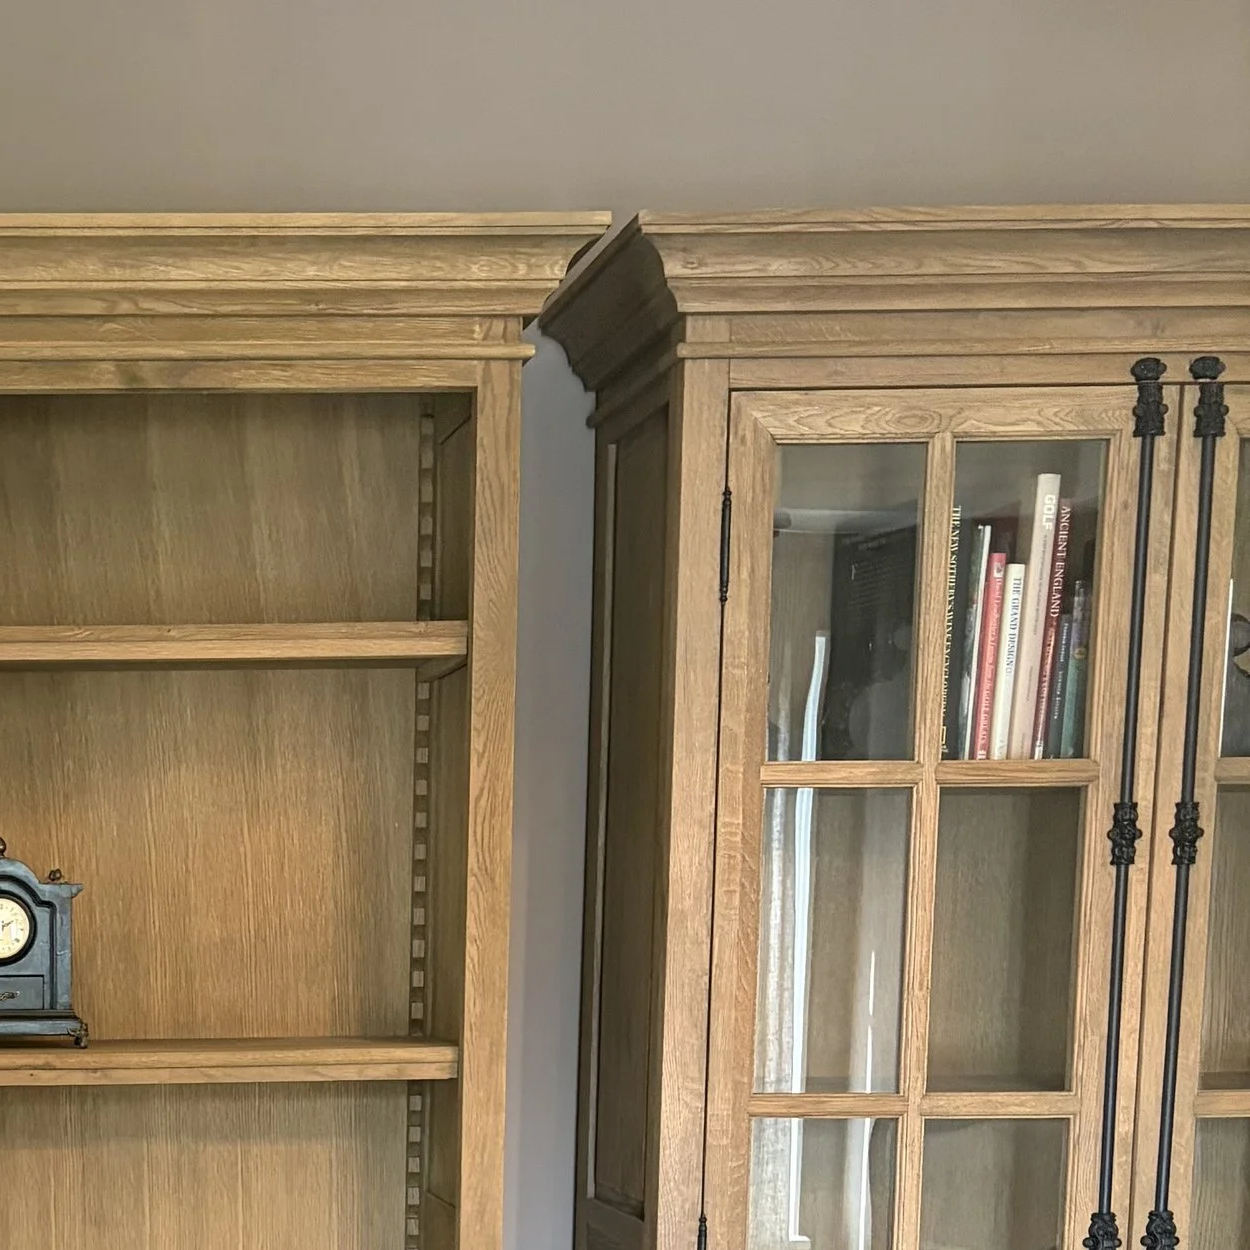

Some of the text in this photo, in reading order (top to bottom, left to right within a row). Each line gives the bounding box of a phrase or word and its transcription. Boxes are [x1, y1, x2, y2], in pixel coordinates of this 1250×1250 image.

[952, 505, 961, 527] THE
[1042, 493, 1056, 531] GOLF
[950, 529, 960, 552] NEW
[1056, 505, 1071, 557] ANCIENT
[1012, 576, 1022, 595] THE
[1050, 561, 1065, 618] ENGLAND
[1009, 597, 1020, 631] GRAND
[1006, 632, 1017, 667] DESIGN
